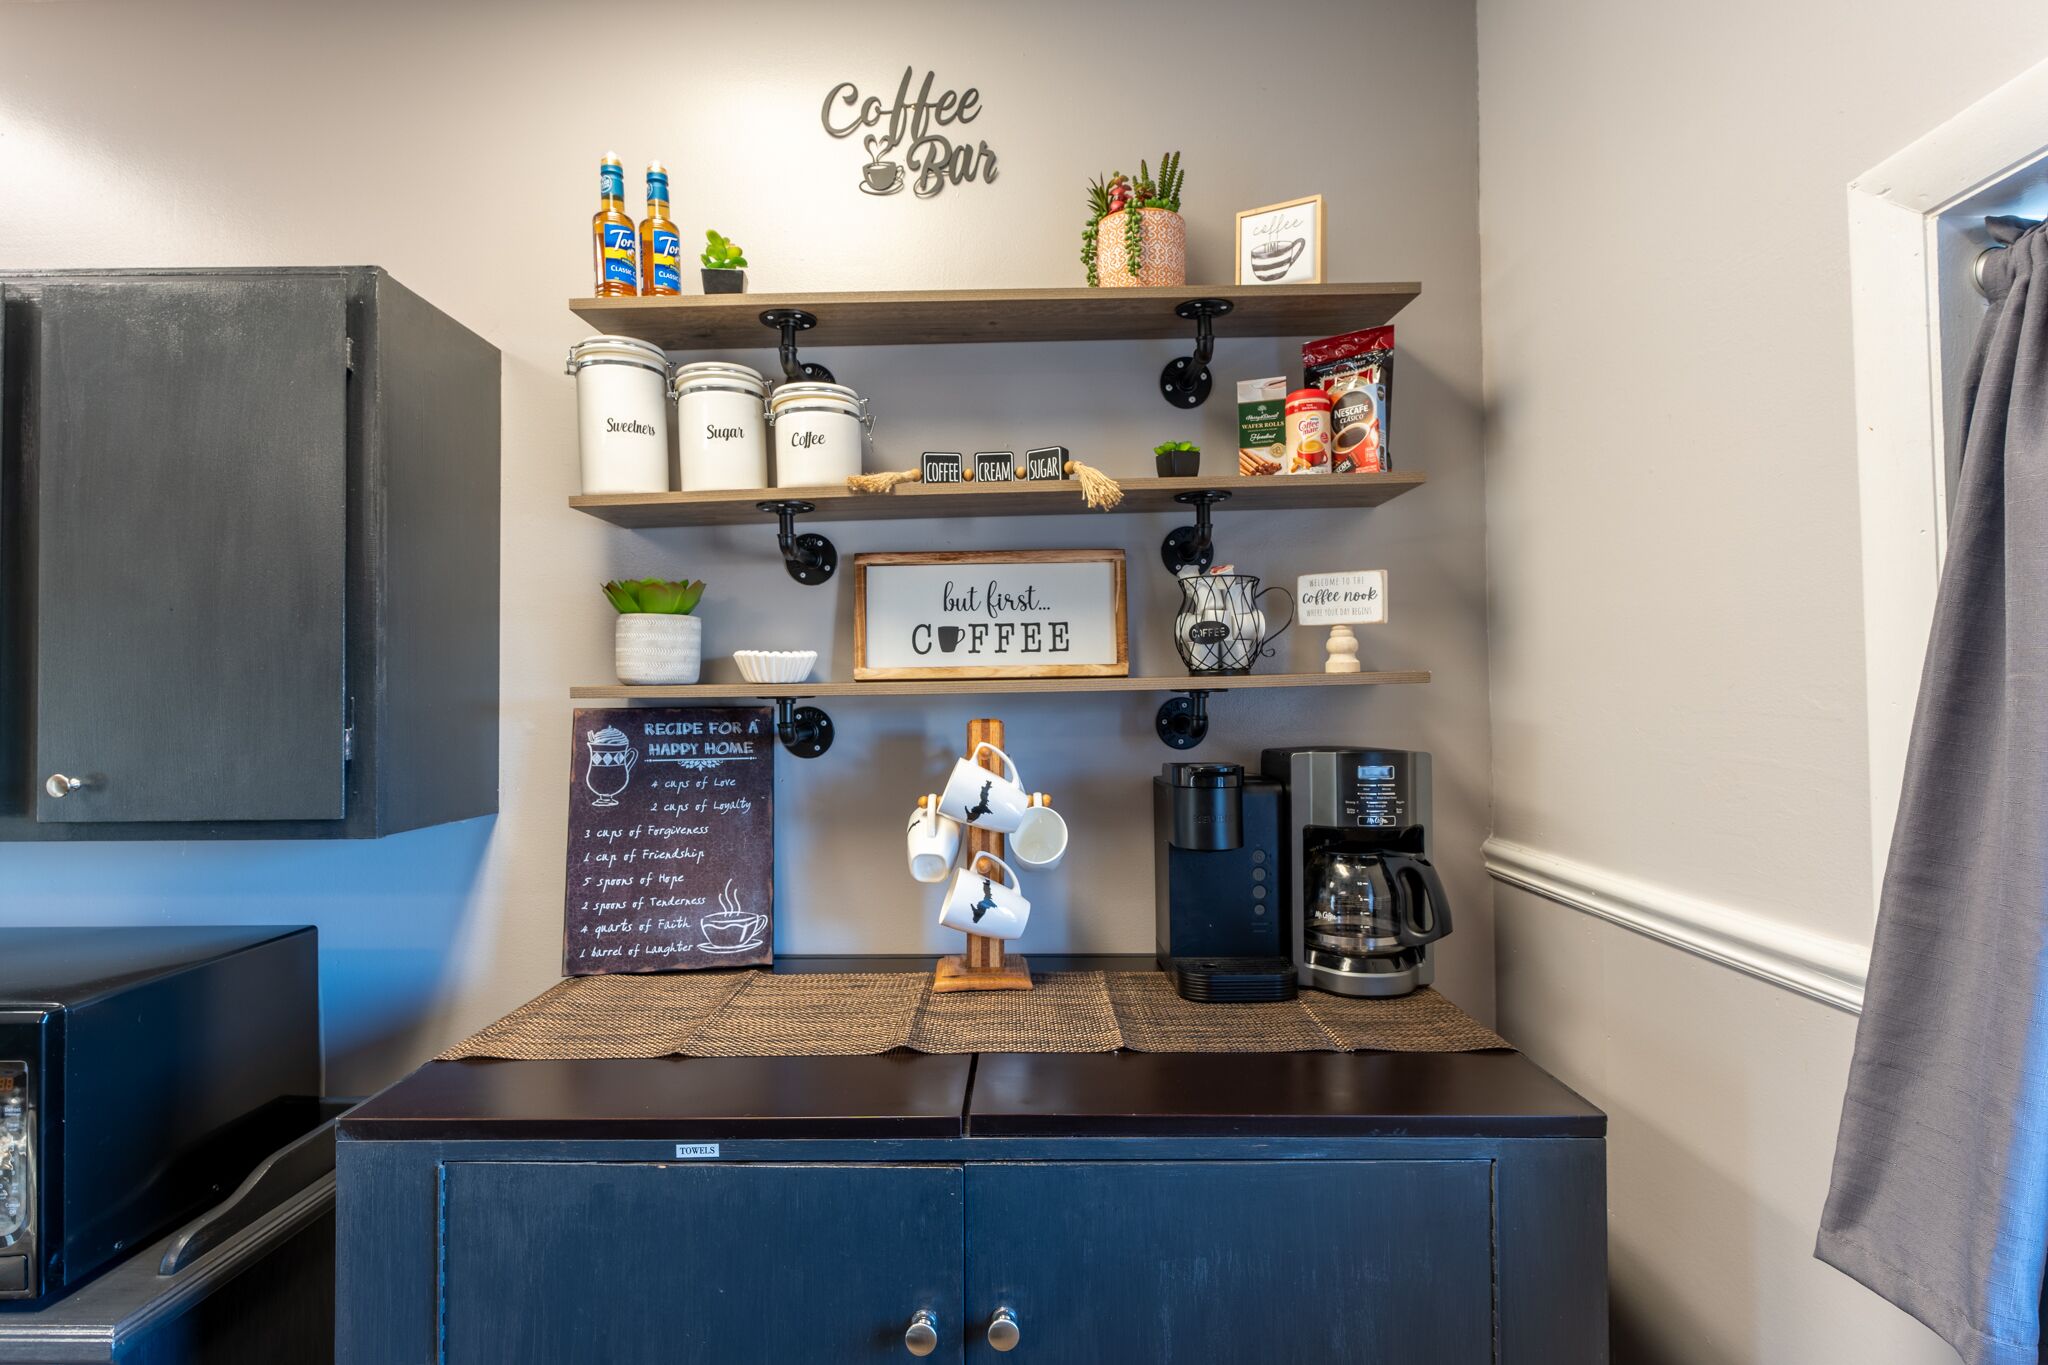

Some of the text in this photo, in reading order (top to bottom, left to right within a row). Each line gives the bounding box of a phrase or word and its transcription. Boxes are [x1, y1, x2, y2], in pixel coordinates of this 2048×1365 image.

[821, 65, 982, 147] Coffee
[906, 134, 998, 197] Bar
[1253, 214, 1303, 235] coffee
[606, 417, 656, 436] Sweetners
[706, 424, 745, 441] Sugar
[791, 432, 826, 449] Coffee
[926, 462, 959, 482] COFFEE
[978, 461, 1011, 482] CREAM
[1029, 456, 1059, 480] SUGAR
[1309, 576, 1364, 587] WELCOME TO THE
[943, 581, 982, 612] but
[1302, 587, 1378, 606] coffee nook
[1306, 607, 1373, 617] WHERE YOUR DAY BEGINS
[911, 621, 1070, 655] CFFEE
[1191, 627, 1226, 639] COFFEE
[644, 721, 759, 736] RECIPE FOR A
[648, 741, 754, 756] HAPPY HOME
[651, 776, 736, 795] 4 cups of Love
[650, 797, 752, 818] 2 cups of Loyalty
[584, 824, 709, 844] 3 cups of Forgiveness
[583, 847, 705, 868] 1 cup of Friendship
[582, 872, 685, 893] 5 spoons of Hope
[581, 896, 706, 916] 2 spoons of Tenderness
[580, 916, 691, 939] 4 quarts of Faith
[579, 941, 694, 958] 1 barrel of Laughter
[680, 1146, 716, 1155] TOWELS
